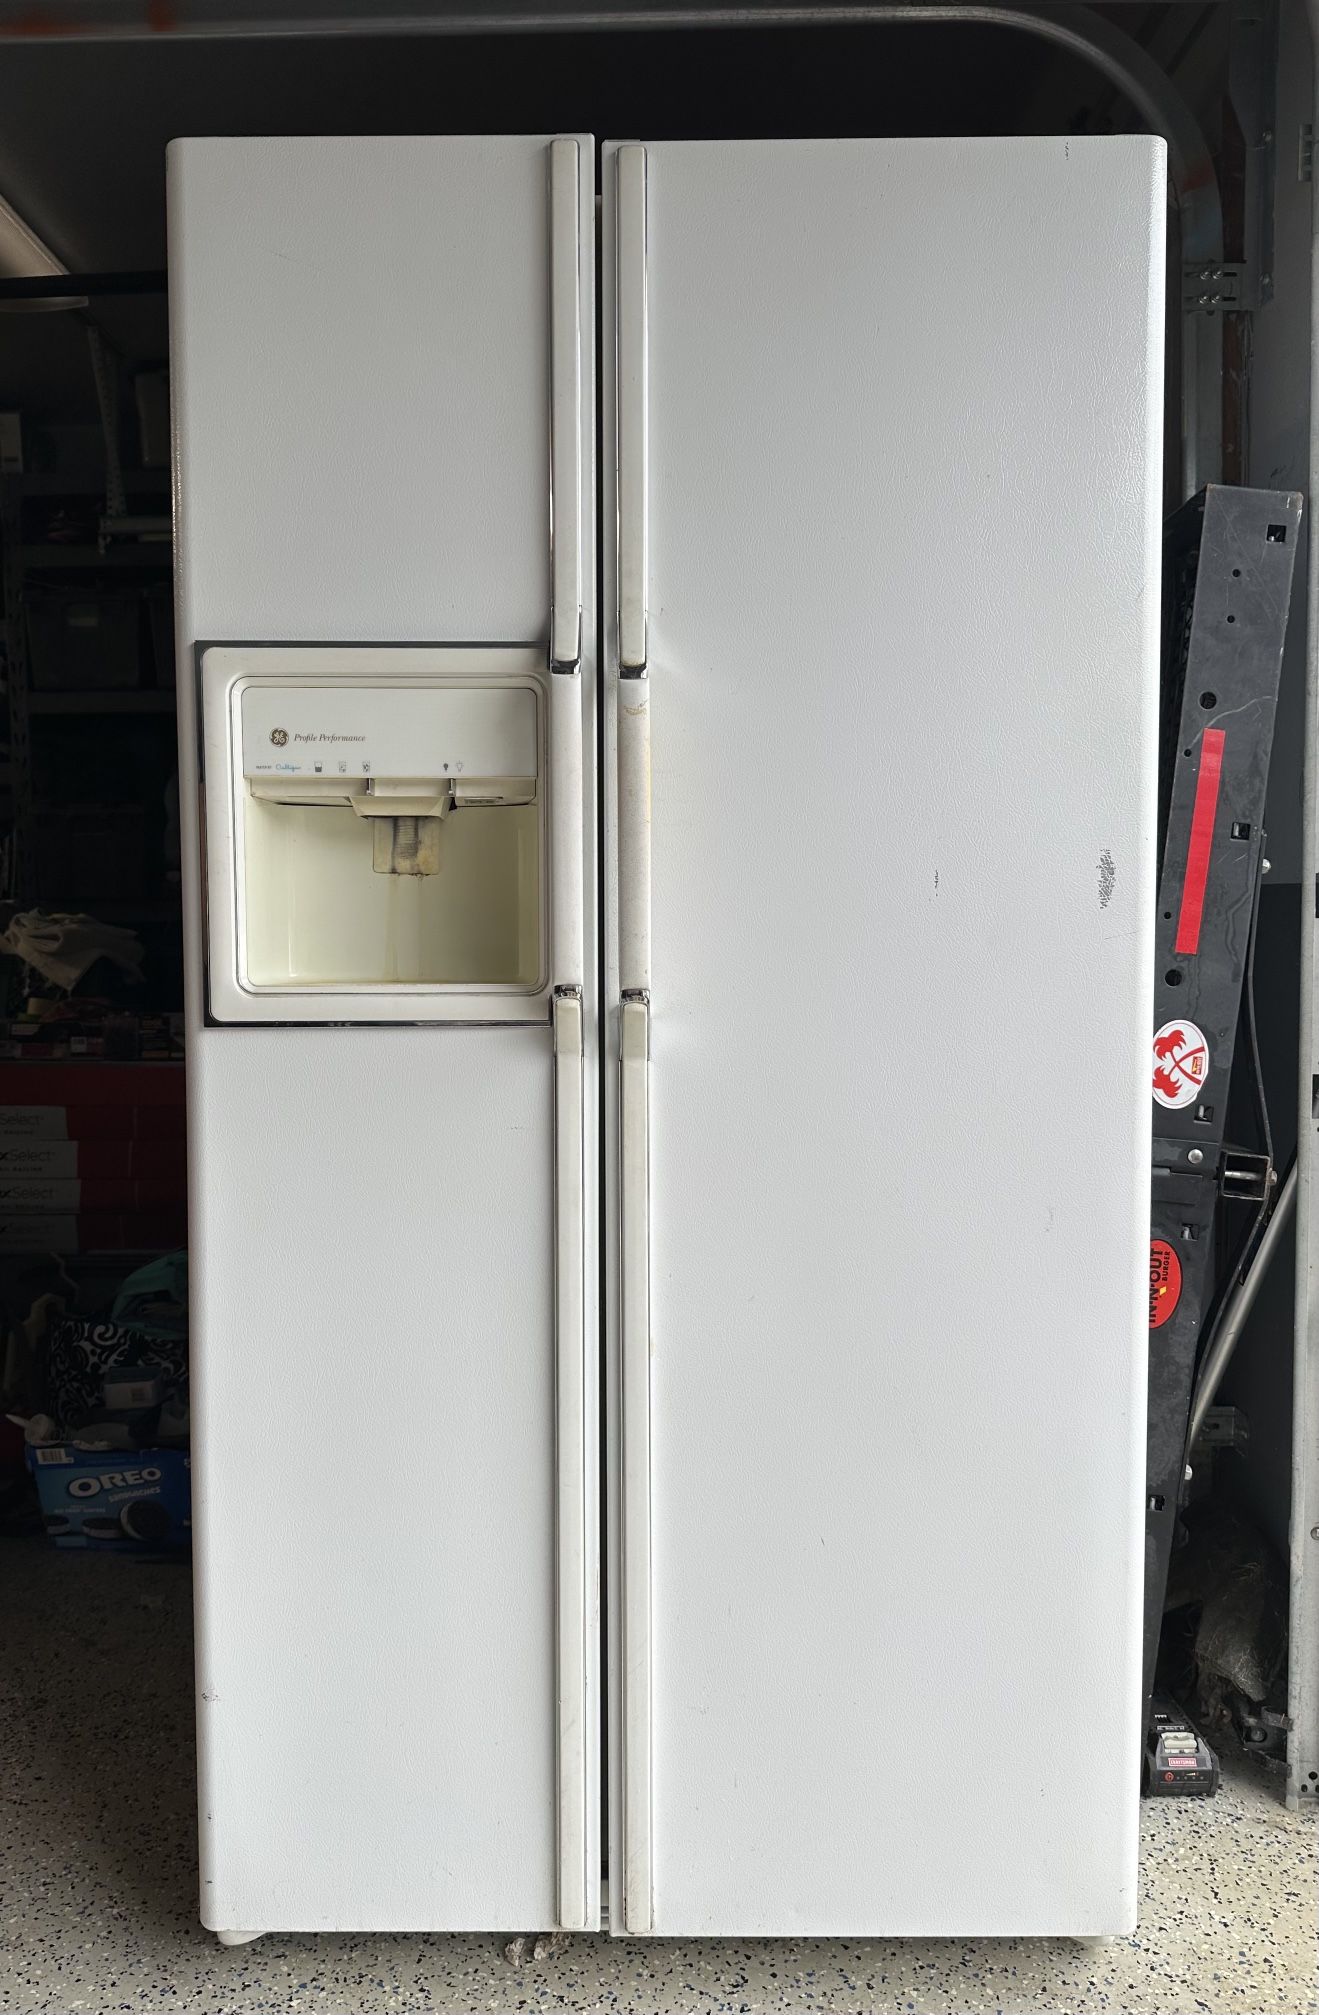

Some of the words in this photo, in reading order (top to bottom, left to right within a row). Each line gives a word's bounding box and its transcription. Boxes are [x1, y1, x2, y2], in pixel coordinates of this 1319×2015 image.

[294, 733, 317, 742] Profile
[319, 733, 366, 743] Performance
[1162, 1250, 1171, 1282] BURGER
[68, 1467, 162, 1497] OREO
